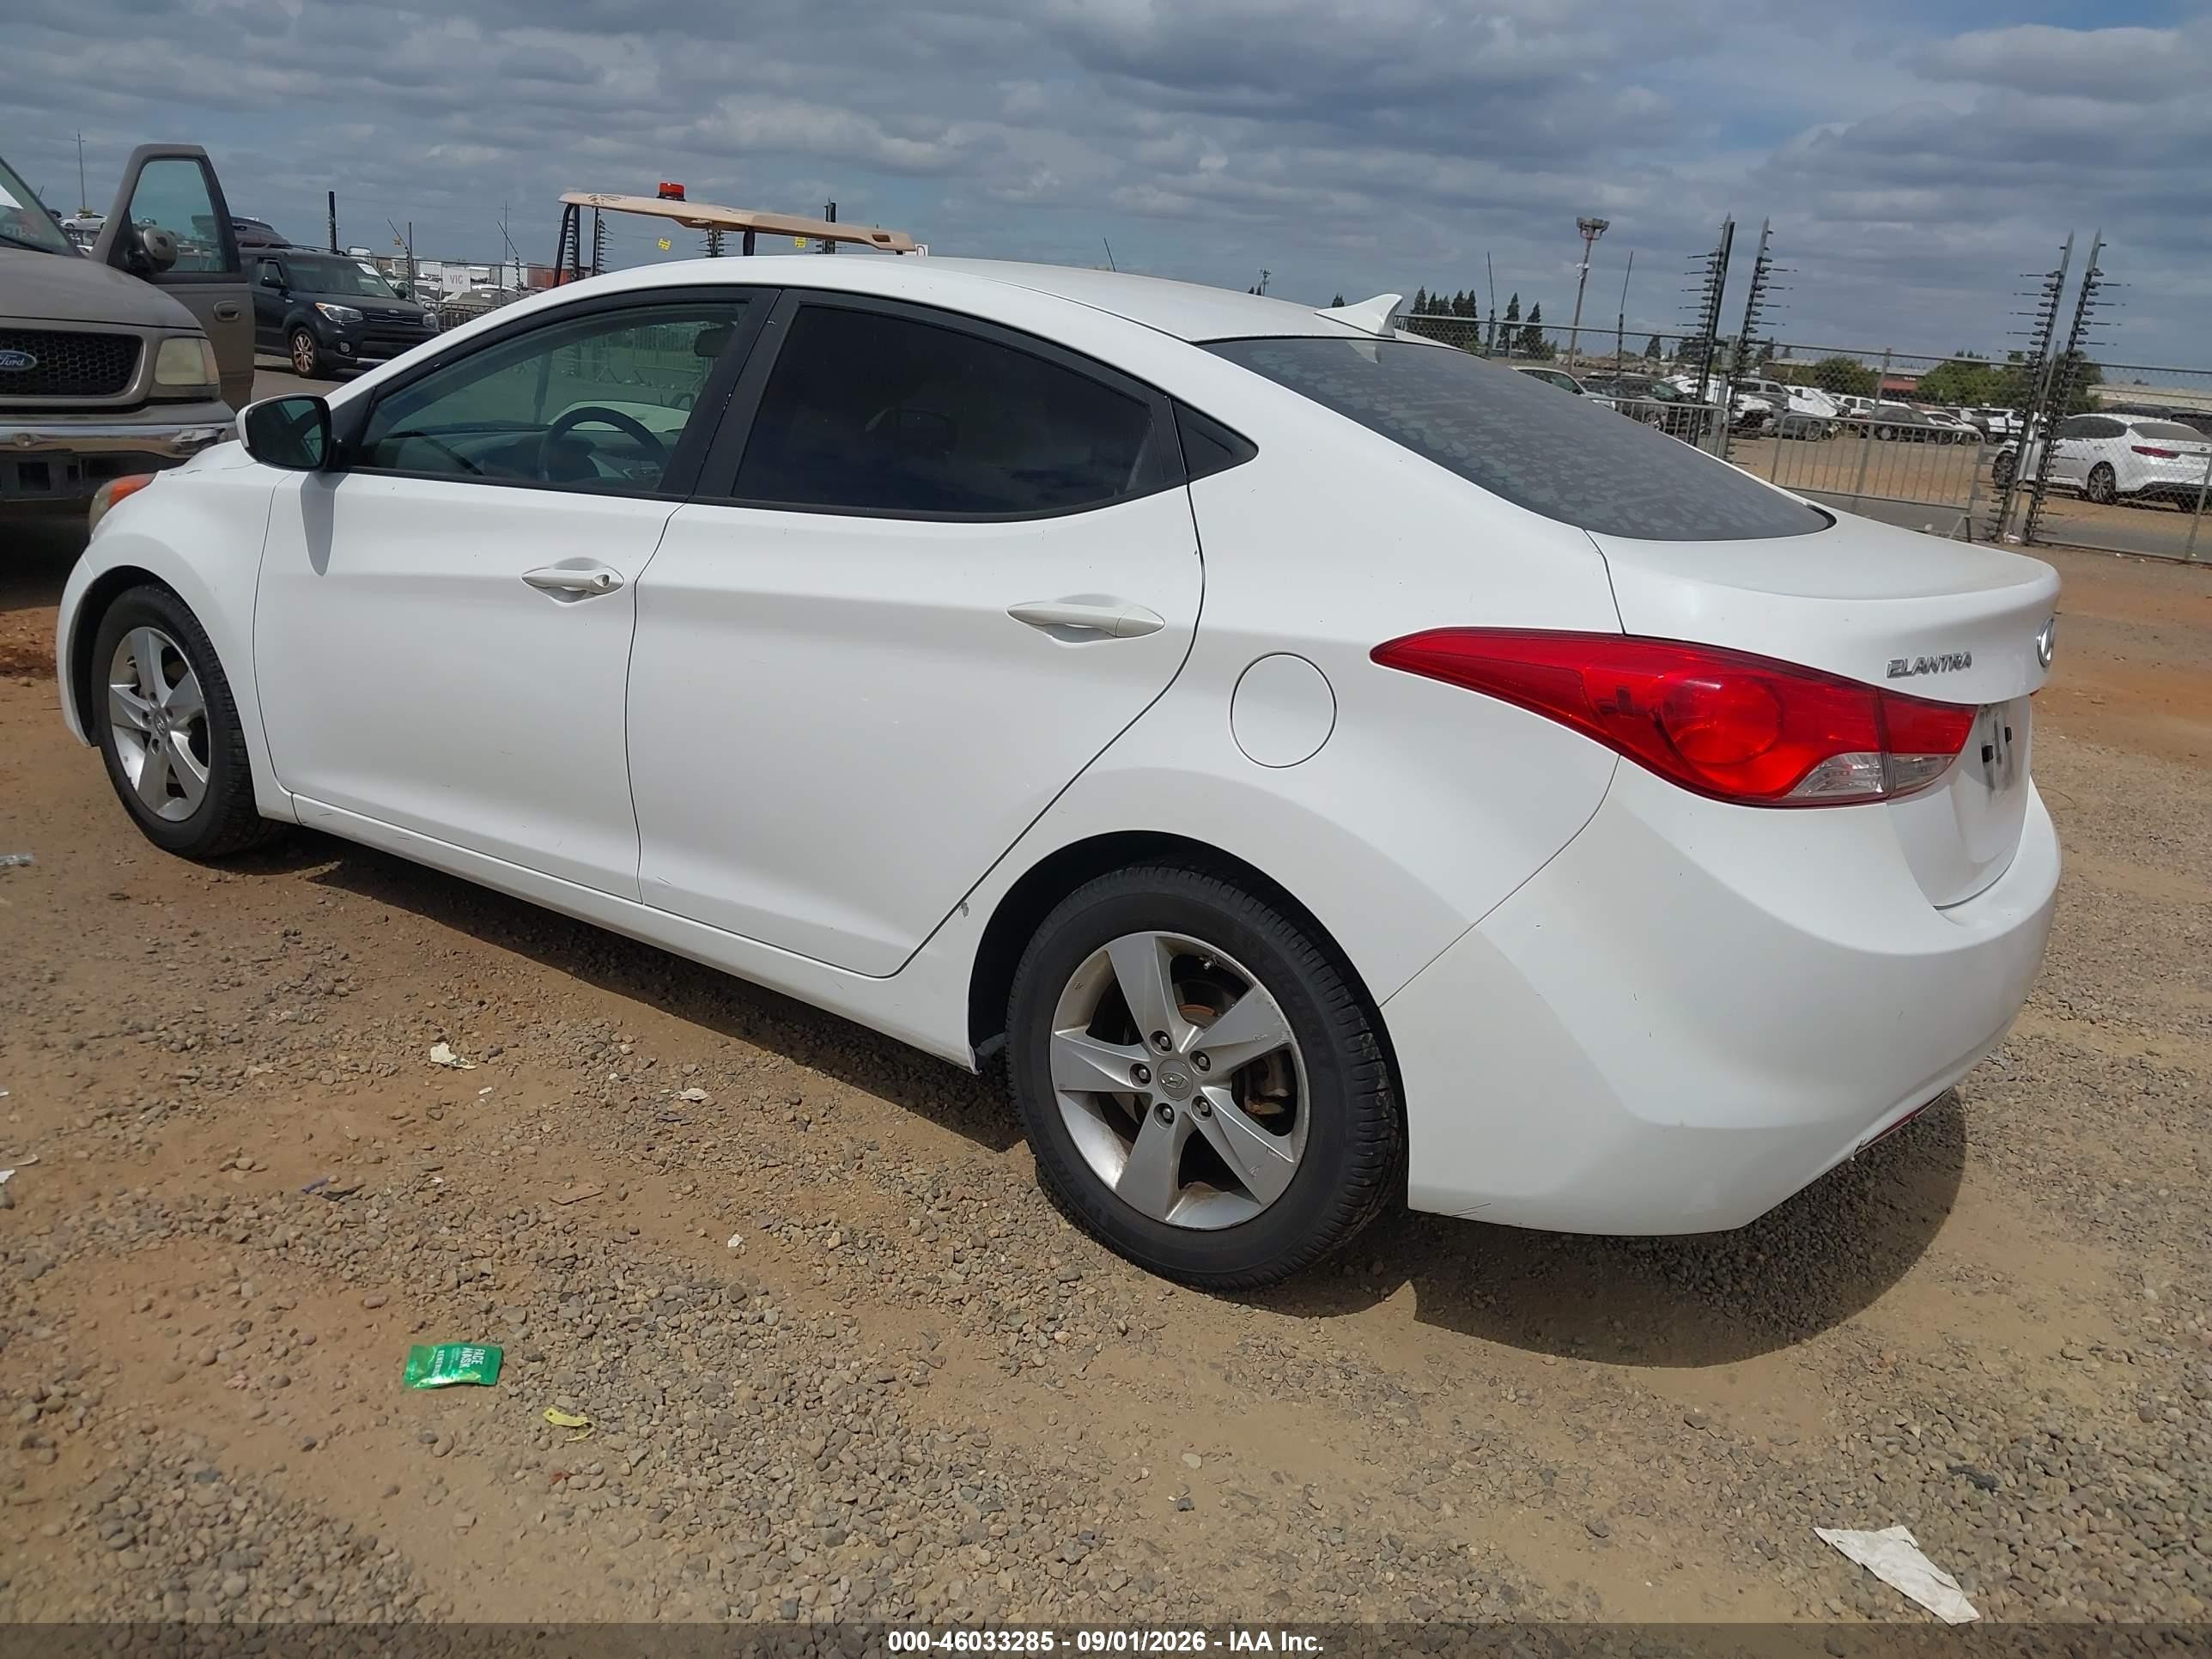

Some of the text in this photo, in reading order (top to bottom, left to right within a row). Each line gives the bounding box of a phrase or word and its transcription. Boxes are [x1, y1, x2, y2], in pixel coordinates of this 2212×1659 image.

[1887, 651, 1972, 678] ELANTRA
[459, 1346, 474, 1369] MASK
[471, 1348, 486, 1365] FACE
